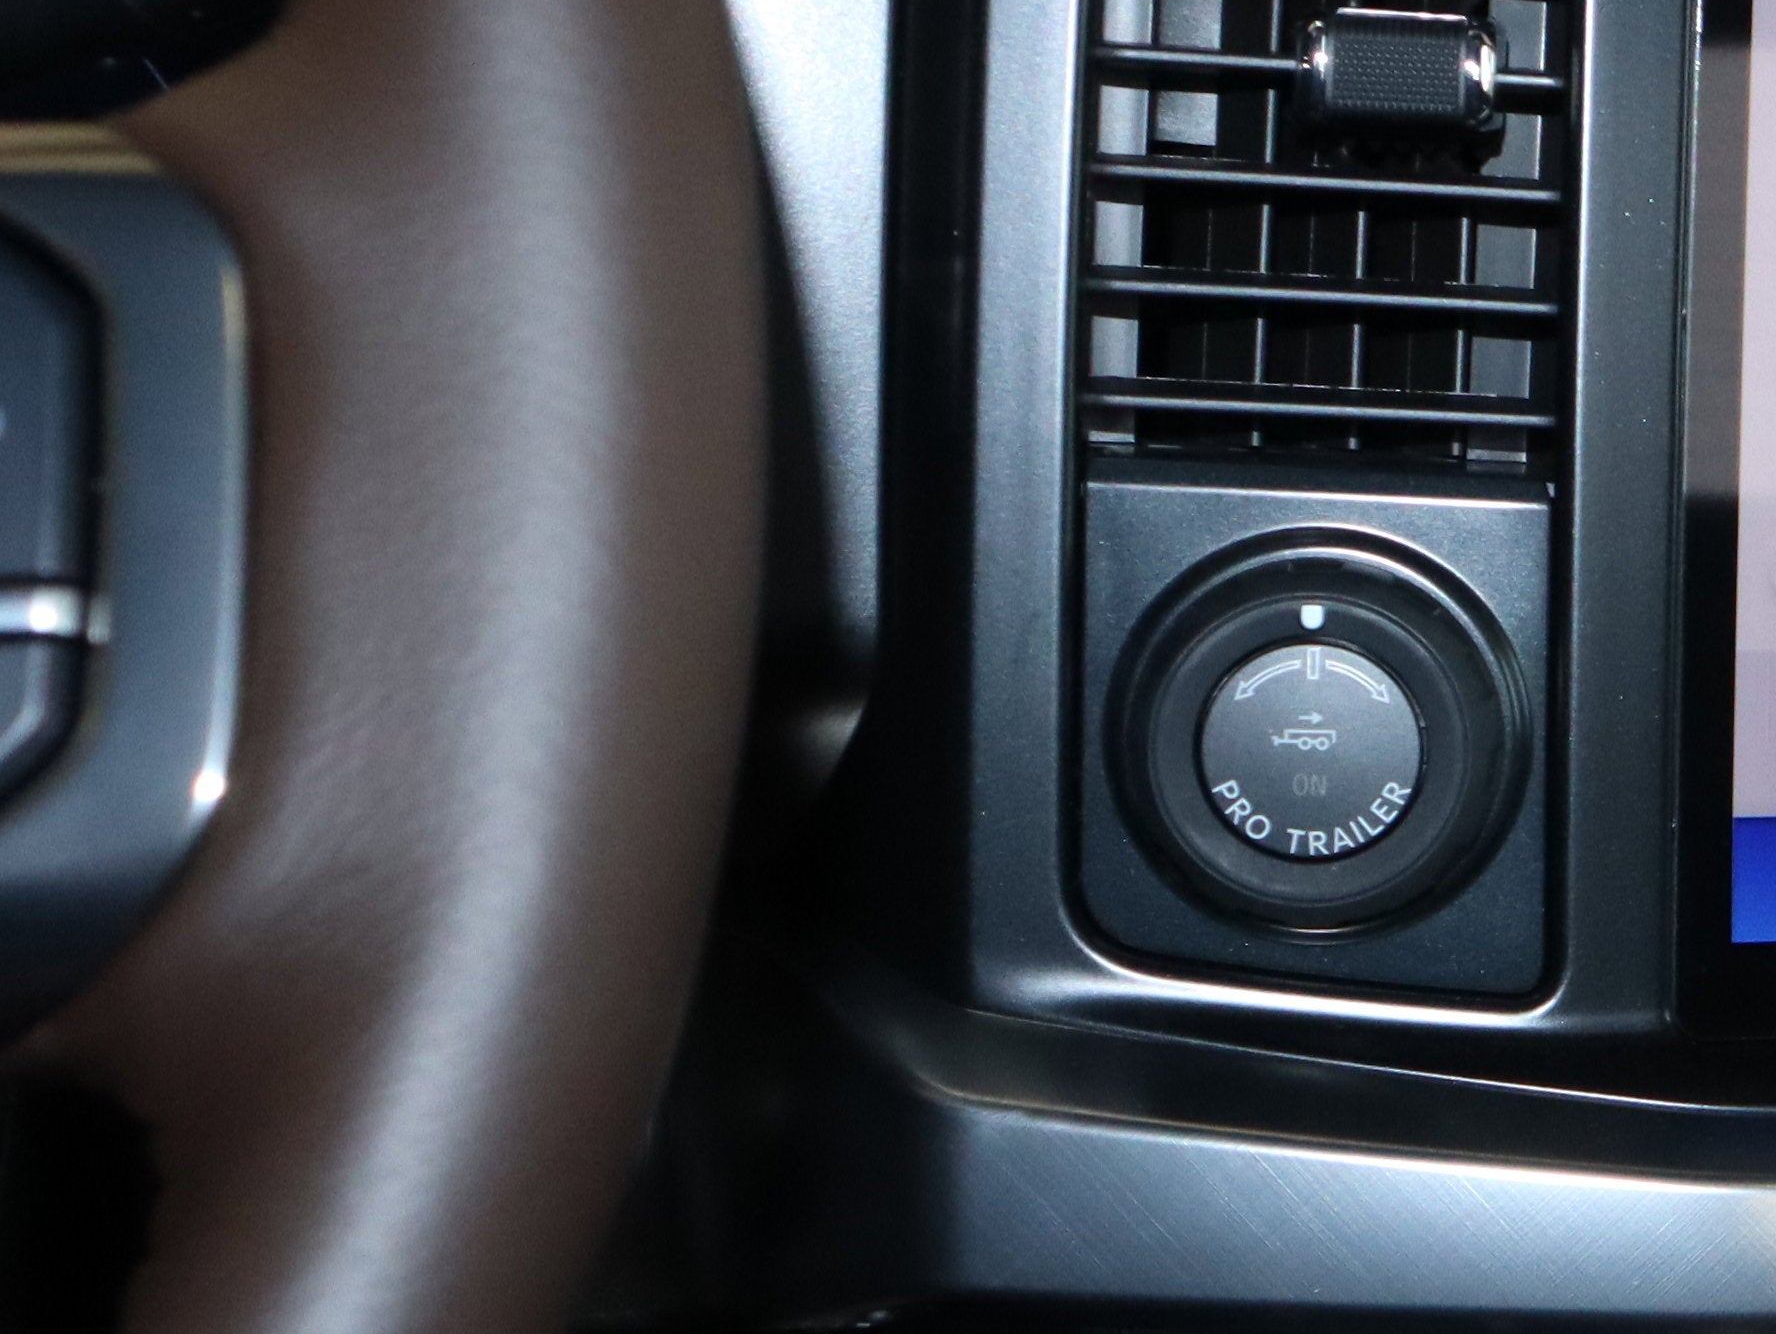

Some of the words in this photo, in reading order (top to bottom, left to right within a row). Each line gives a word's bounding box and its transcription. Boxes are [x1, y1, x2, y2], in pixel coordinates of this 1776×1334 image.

[1292, 774, 1327, 797] ON
[1211, 779, 1272, 841] PRO
[1286, 780, 1412, 856] TRAILER
